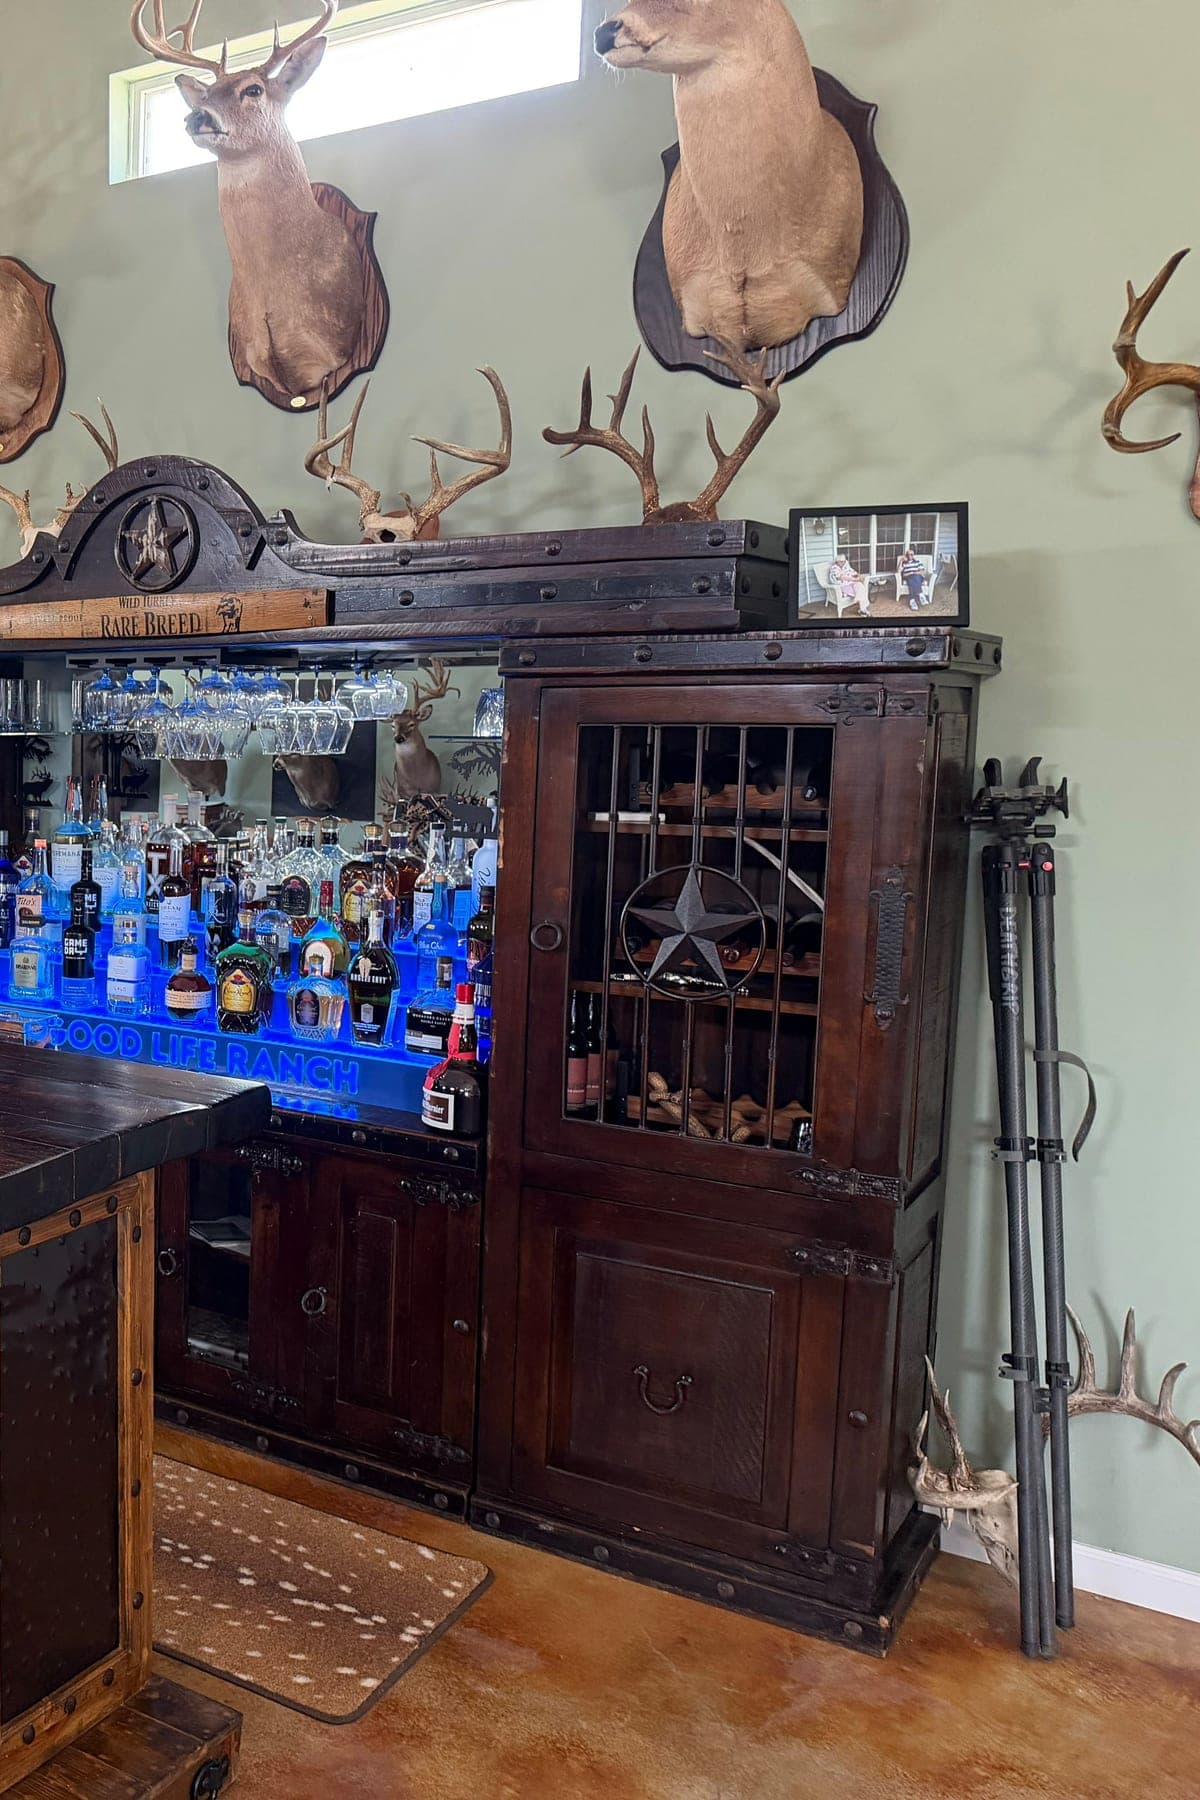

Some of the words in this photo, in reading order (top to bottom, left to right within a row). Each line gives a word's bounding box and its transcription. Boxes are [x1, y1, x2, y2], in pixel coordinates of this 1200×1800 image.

[119, 596, 140, 609] WILD
[101, 613, 140, 637] RARE
[144, 611, 202, 636] BREED
[17, 897, 37, 906] Tito's
[64, 938, 88, 947] GAME
[151, 1031, 218, 1072] LIFE
[226, 1042, 360, 1097] RANCH
